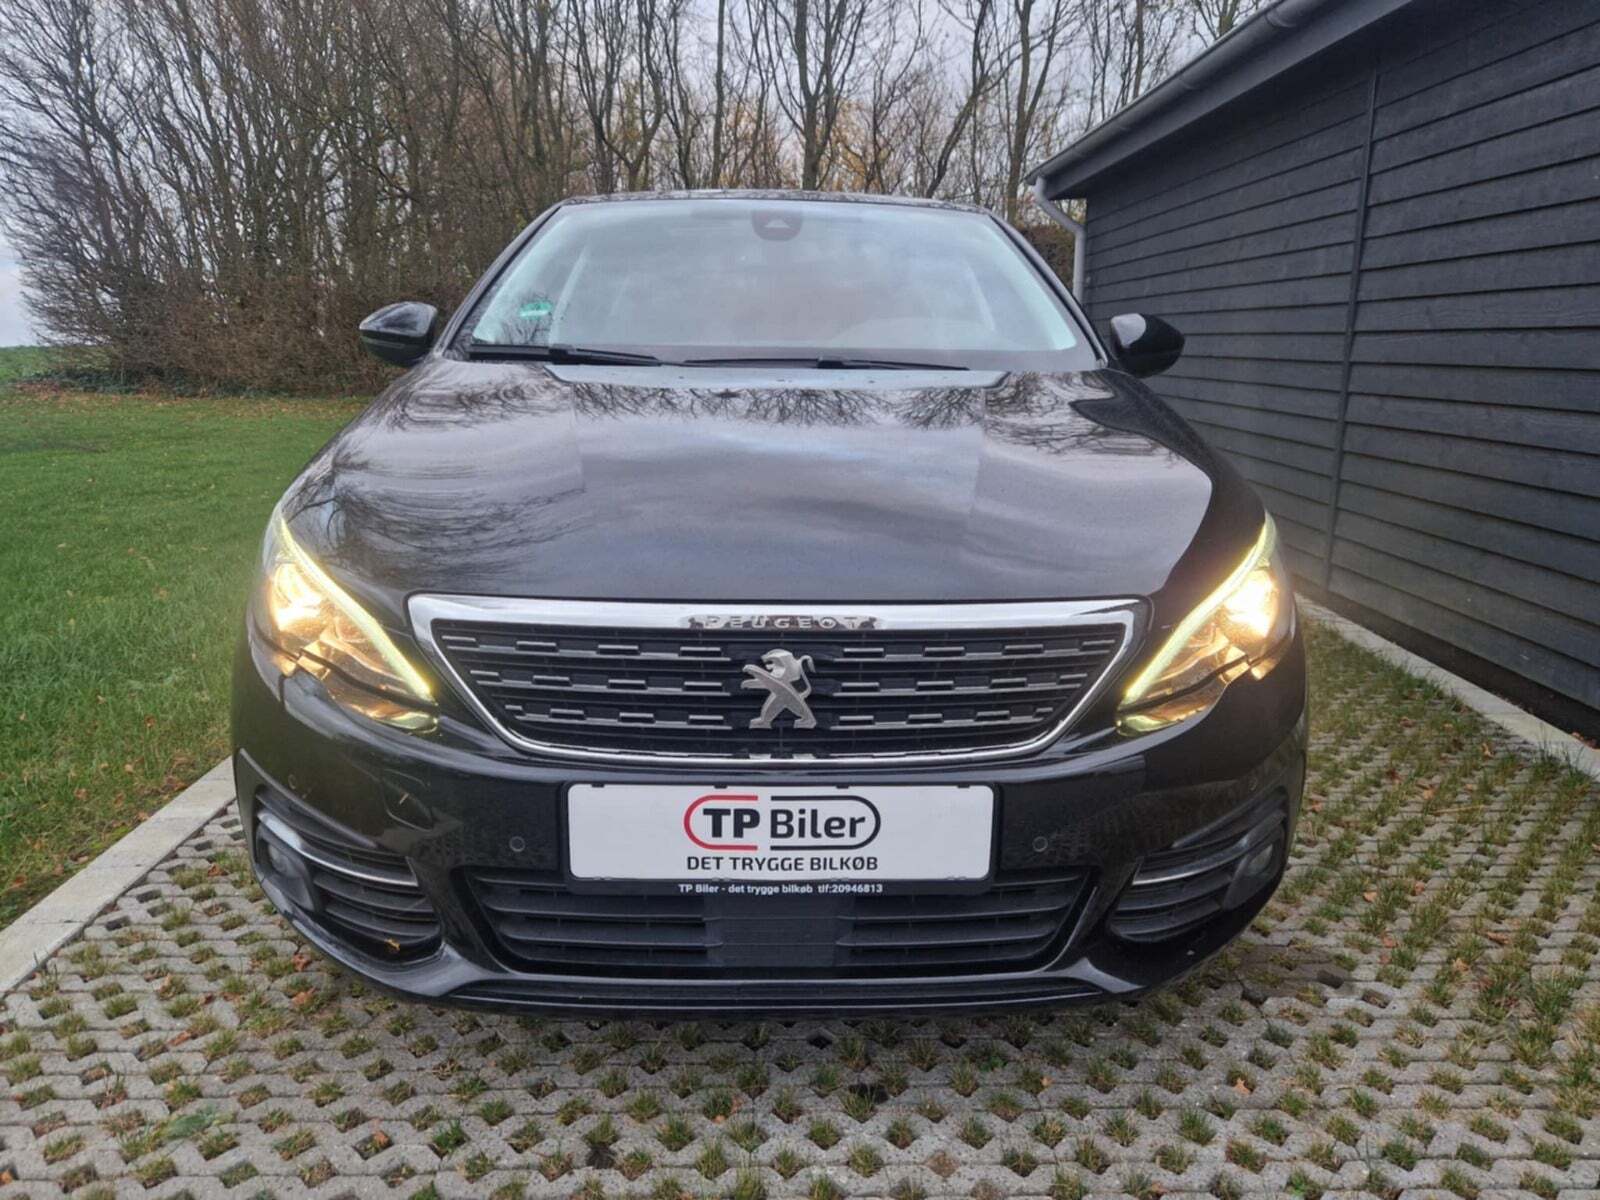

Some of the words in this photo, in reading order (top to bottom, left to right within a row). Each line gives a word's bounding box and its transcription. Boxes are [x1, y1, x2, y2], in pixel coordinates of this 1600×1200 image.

[705, 615, 858, 629] PEUGEOT
[703, 808, 760, 838] TP
[770, 808, 865, 838] Biler
[686, 856, 724, 871] DET
[728, 856, 804, 872] TRYGGE
[809, 856, 879, 871] BILKØB
[678, 884, 693, 893] TP
[695, 884, 719, 893] Biler
[728, 884, 745, 893] det
[747, 885, 780, 895] trygge
